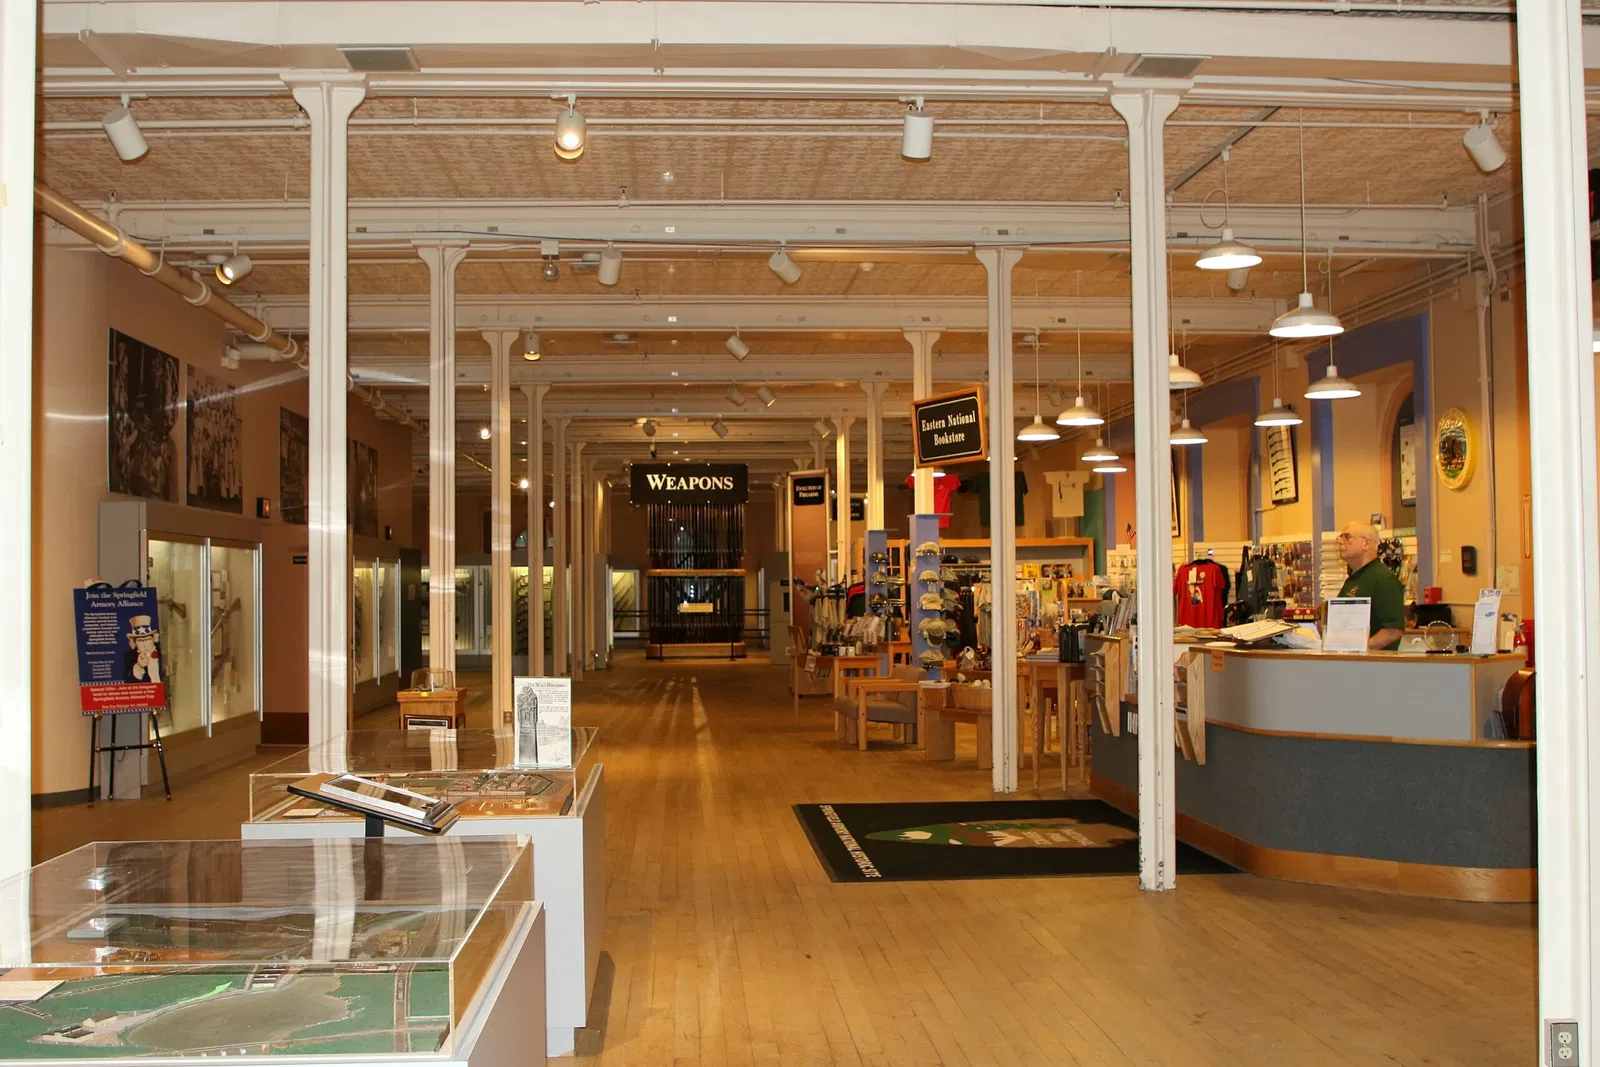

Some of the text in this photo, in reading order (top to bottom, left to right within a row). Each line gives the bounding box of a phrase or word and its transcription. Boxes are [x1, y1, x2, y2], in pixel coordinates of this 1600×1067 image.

[921, 410, 976, 431] Eastern National
[933, 432, 965, 446] Bookstore
[646, 474, 734, 490] WEAPONS
[85, 591, 99, 600] Join
[112, 590, 147, 599] Springfield
